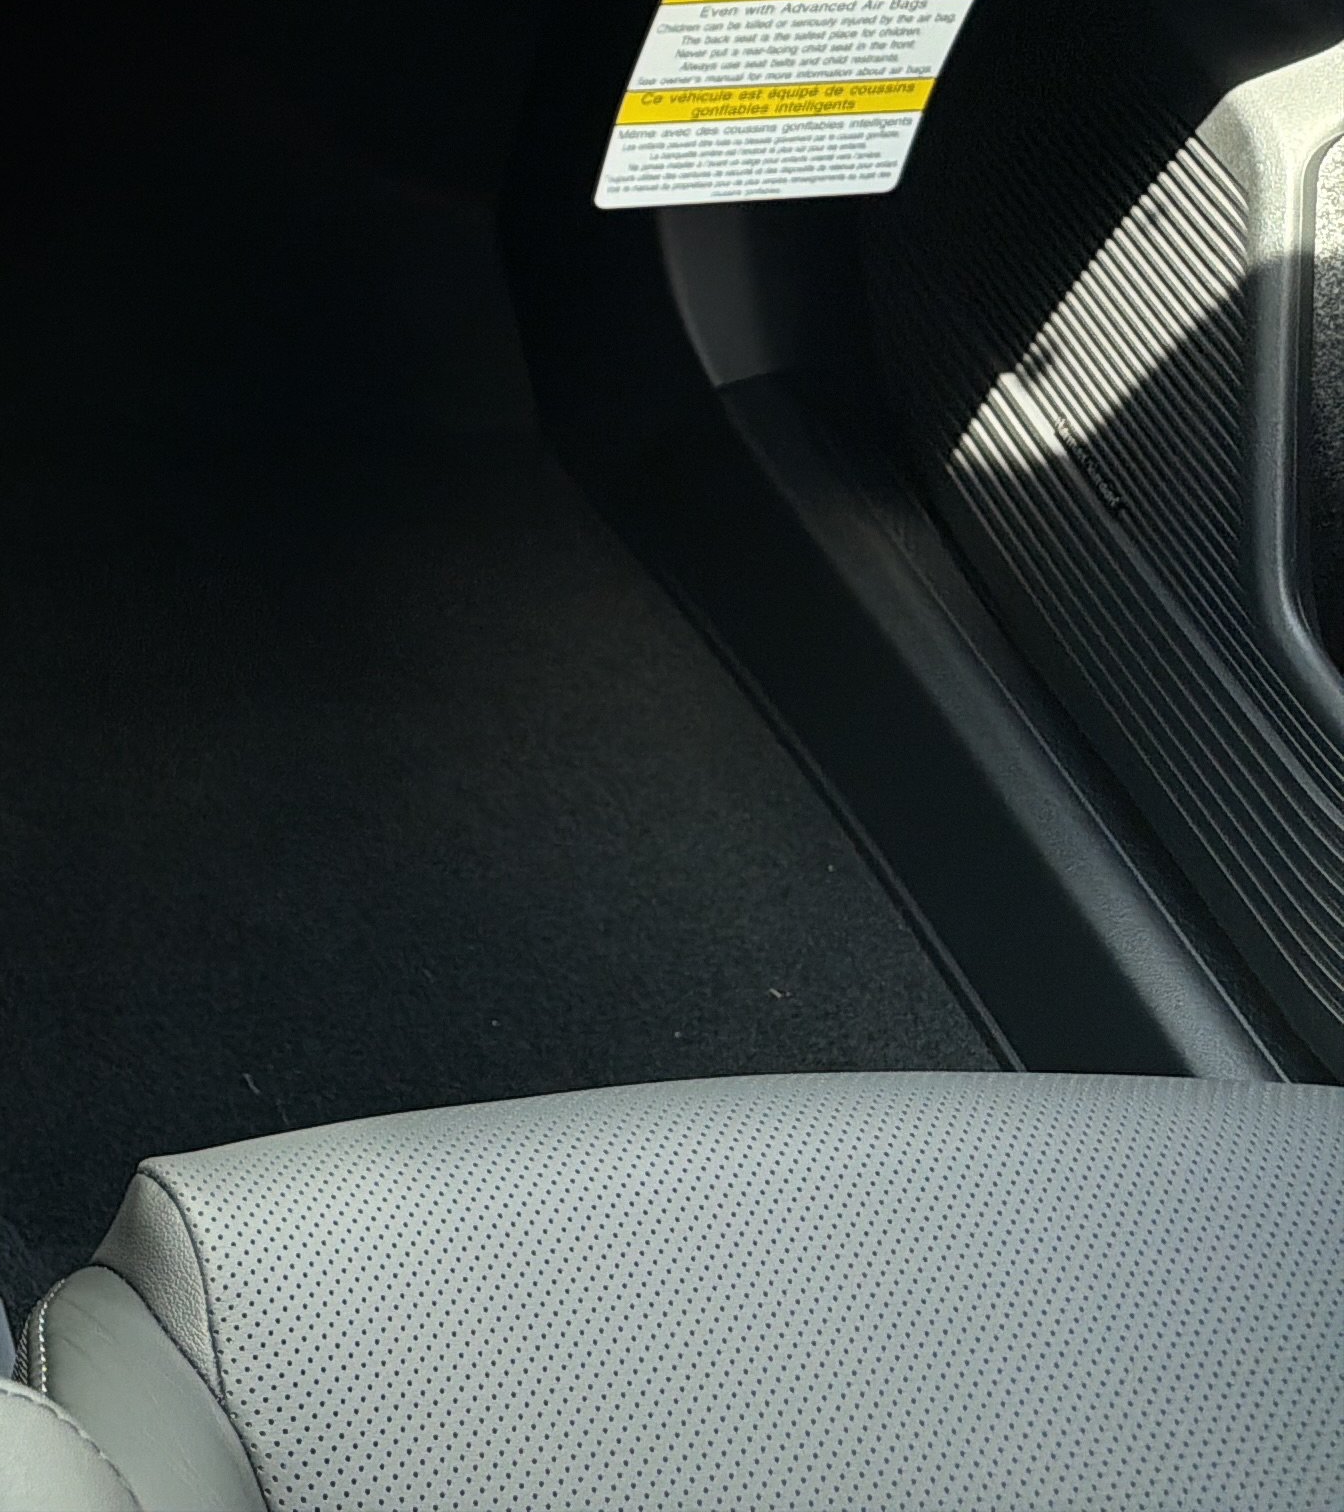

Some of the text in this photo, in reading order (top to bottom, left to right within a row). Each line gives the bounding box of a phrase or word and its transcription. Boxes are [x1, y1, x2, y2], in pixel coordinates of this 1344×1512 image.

[699, 4, 739, 19] Even
[744, 2, 776, 16] with
[780, 0, 857, 15] Advanced
[861, 0, 886, 12] Air
[879, 14, 893, 26] by
[896, 13, 915, 24] the
[640, 92, 663, 106] Ce
[737, 89, 763, 101] est
[824, 85, 844, 96] de
[849, 82, 916, 96] coussins
[690, 99, 856, 120] gonflables intelligents
[695, 125, 719, 136] des
[723, 124, 777, 135] coussins
[781, 120, 845, 134] gonflables
[848, 116, 913, 129] intelligents
